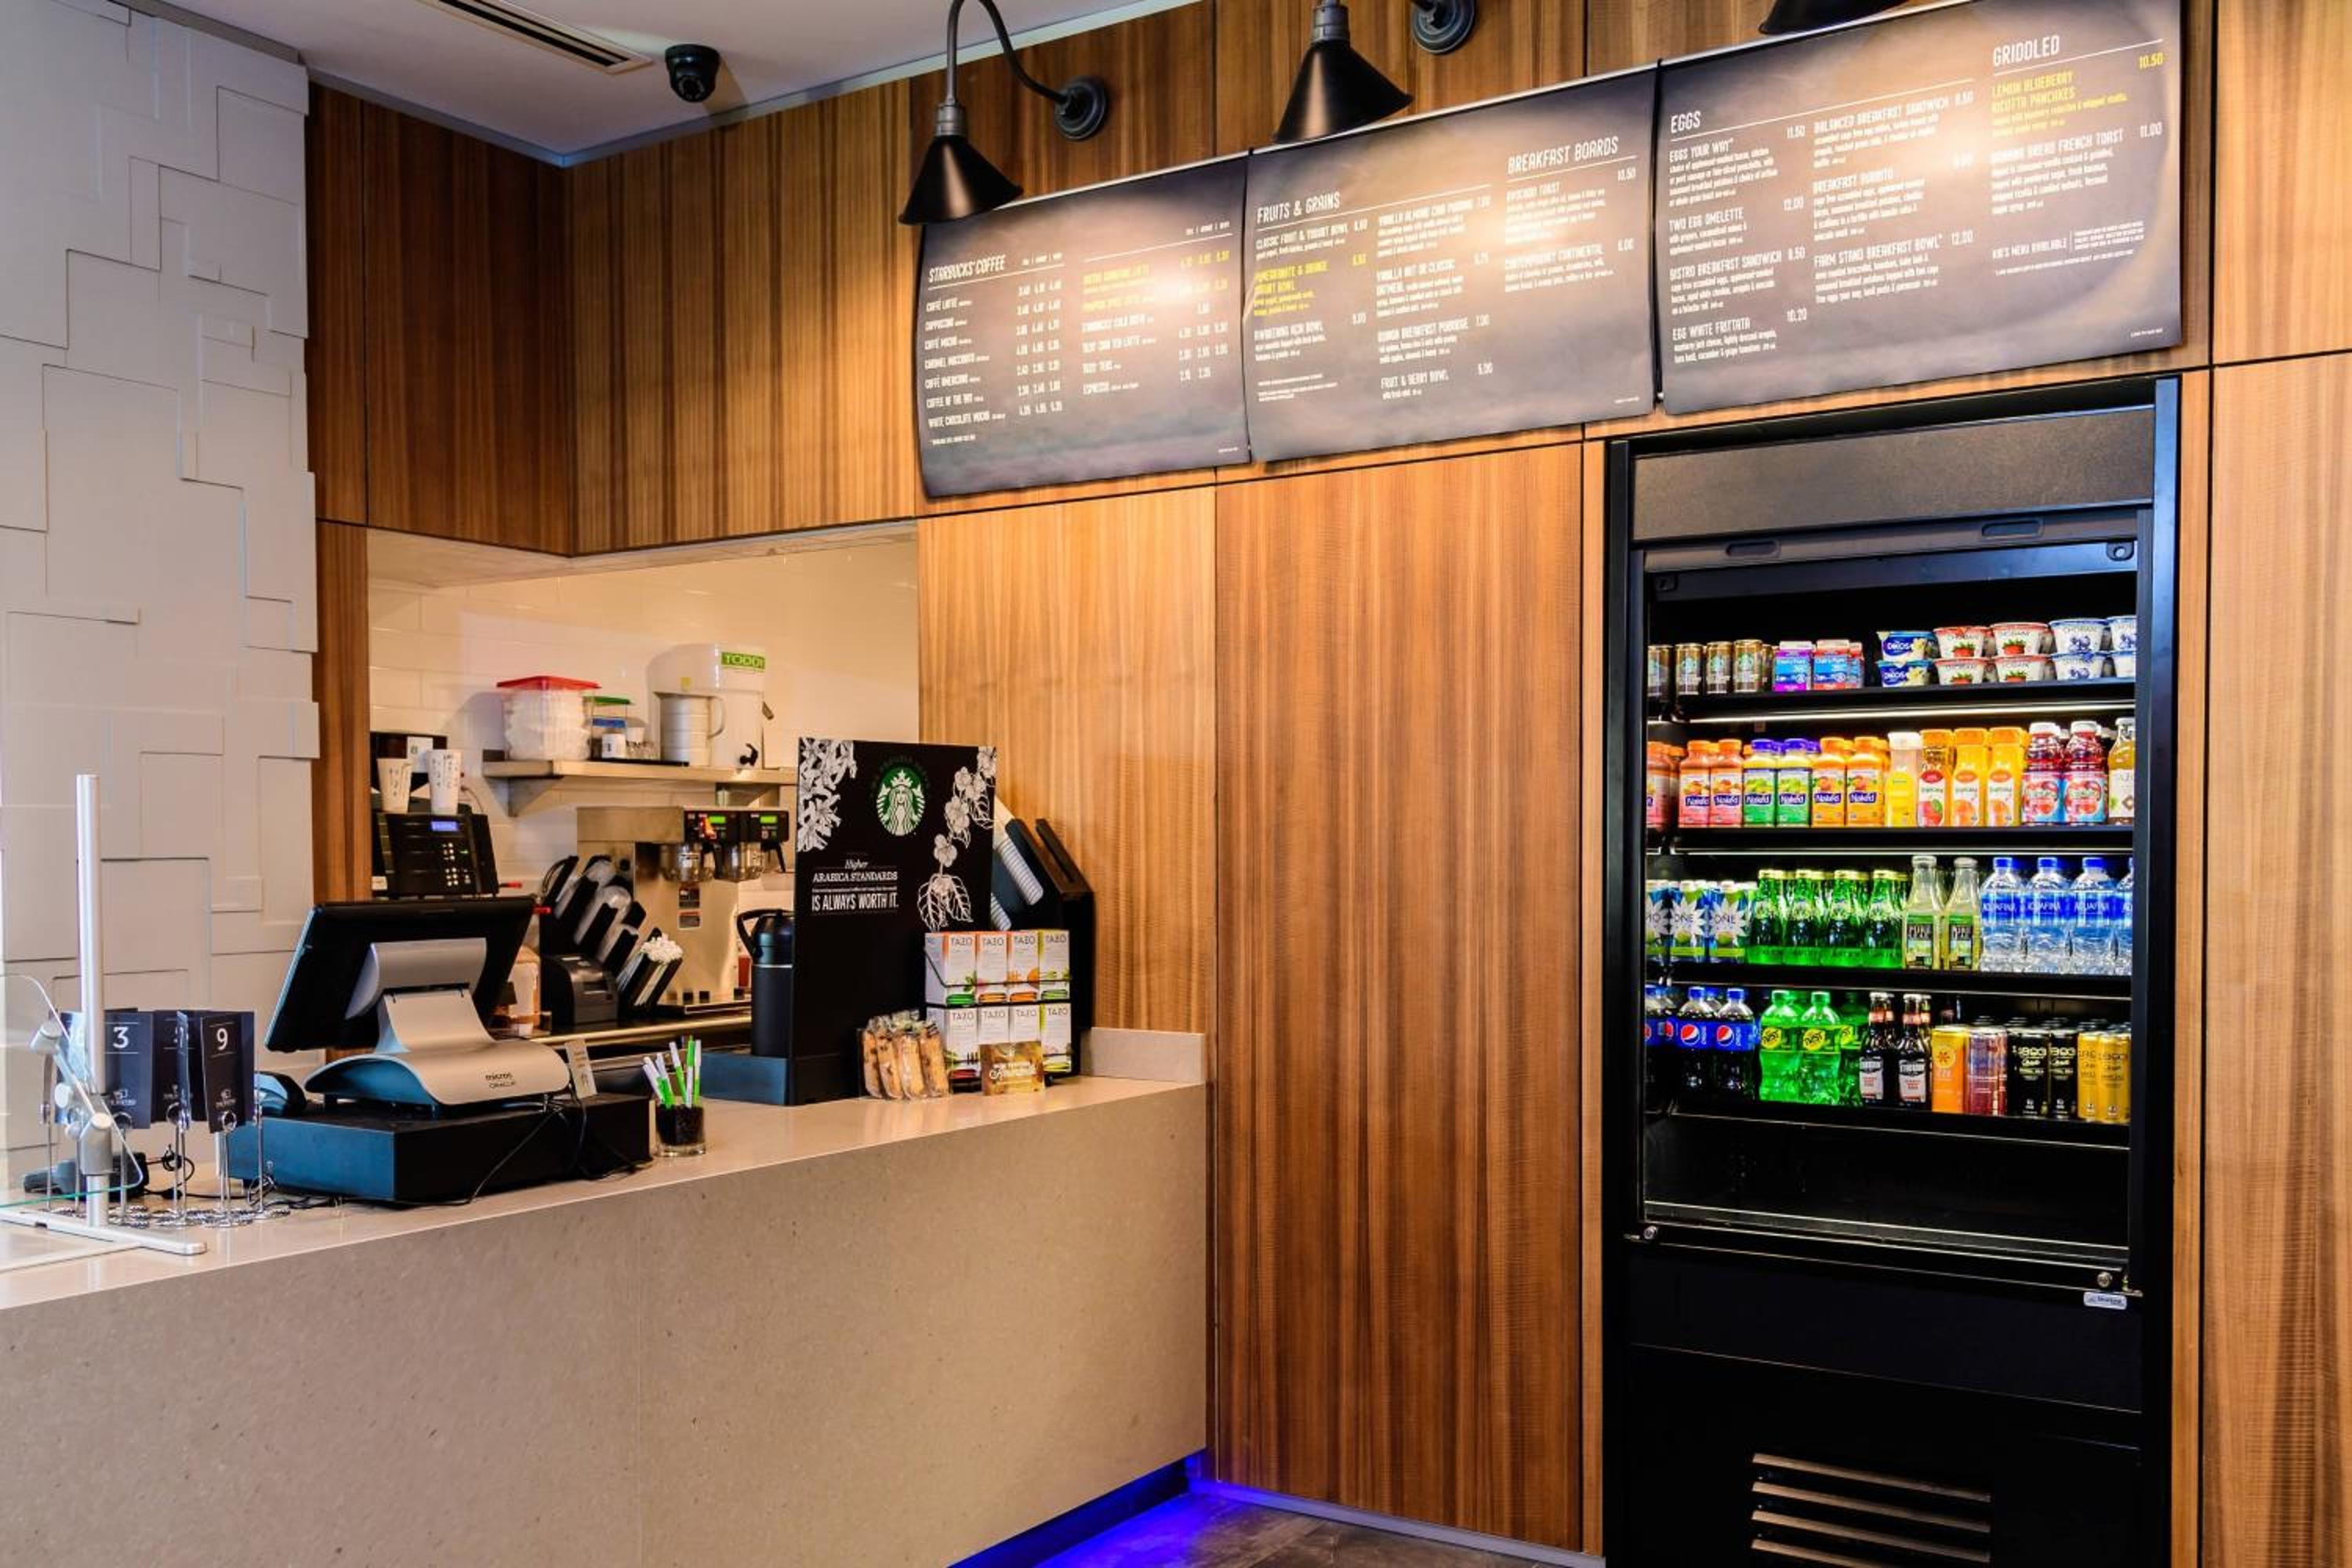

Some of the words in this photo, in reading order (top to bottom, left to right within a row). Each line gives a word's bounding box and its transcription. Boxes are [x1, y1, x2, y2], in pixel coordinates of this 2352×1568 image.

[1994, 34, 2060, 67] GRIDDLED
[2140, 52, 2164, 71] 10.50
[1671, 111, 1701, 134] EGGS
[2058, 134, 2093, 152] FRENCH
[2096, 128, 2125, 146] TOAST
[1508, 144, 1571, 174] BREAKFAST
[1574, 136, 1619, 162] BOARDS
[1669, 147, 1688, 164] EGGS
[1691, 143, 1709, 159] YOUR
[1257, 201, 1290, 225] FRUITS
[1294, 200, 1302, 216] &
[1305, 191, 1341, 214] GRAINS
[1669, 217, 1686, 232] TWO
[1689, 213, 1703, 228] EGG
[1705, 206, 1744, 224] OMELETTE
[1256, 235, 1279, 250] CLASSIC
[1814, 253, 1836, 267] FARM
[1838, 249, 1864, 264] STAND
[1867, 240, 1912, 259] BREAKFAST
[975, 254, 1006, 274] COFFEE
[1670, 265, 1696, 281] BISTRO
[1698, 257, 1740, 277] BREAKFAST
[1742, 250, 1782, 268] SANDWICH
[1673, 327, 1687, 340] EGG
[1689, 322, 1713, 337] WHITE
[1715, 317, 1751, 334] FRITTATA
[1381, 376, 1399, 390] FRUIT
[1746, 794, 1770, 805] Naked
[1780, 793, 1806, 805] Naked
[1850, 792, 1876, 804] Naked
[844, 858, 869, 871] Higher
[813, 873, 849, 883] ARABICA
[851, 871, 898, 882] STANDARDS
[812, 894, 821, 912] IS
[822, 893, 856, 910] ALWAYS
[858, 893, 887, 909] WORTH
[889, 892, 899, 908] IT.
[951, 937, 973, 947] TAZO
[982, 936, 1004, 946] TAZO
[113, 1026, 129, 1049] 3
[216, 1028, 228, 1051] 9
